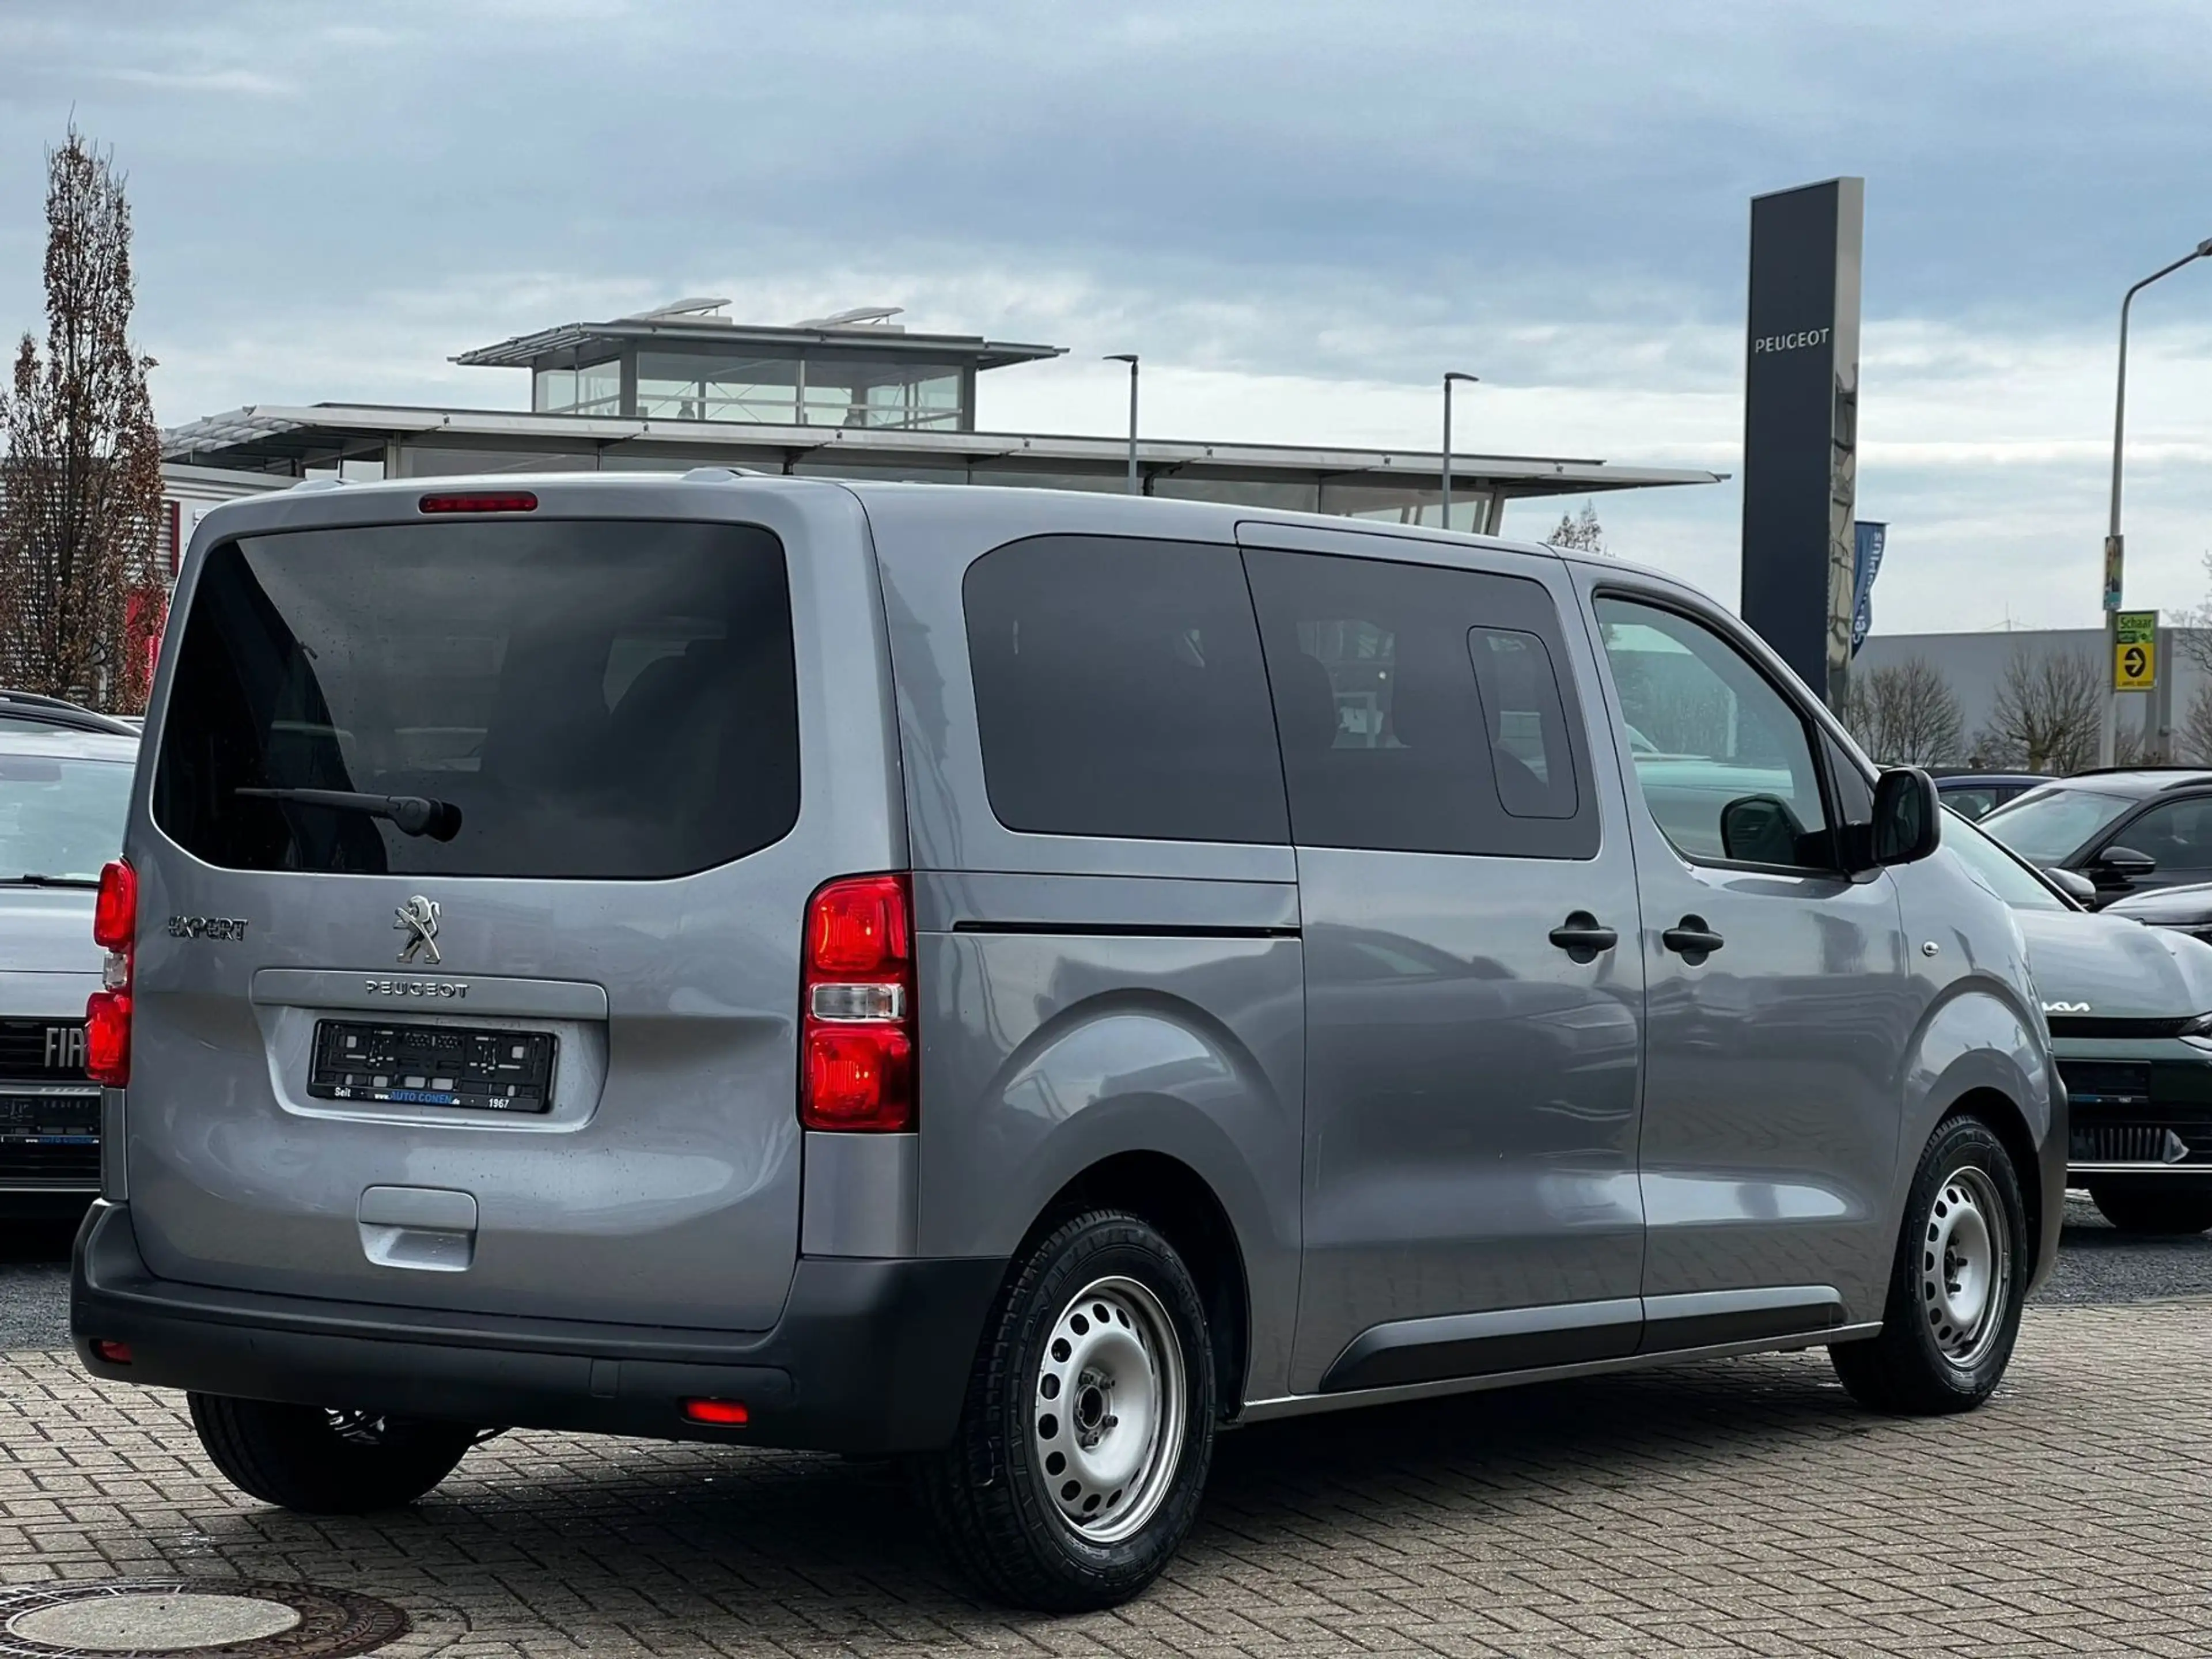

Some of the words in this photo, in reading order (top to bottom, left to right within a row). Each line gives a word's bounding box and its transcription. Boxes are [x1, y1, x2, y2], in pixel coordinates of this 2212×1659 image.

[1755, 328, 1830, 353] PEUGEOT
[2120, 616, 2152, 628] Schaar
[168, 916, 248, 941] EXPERT
[365, 980, 469, 998] PEUGEOT
[45, 1028, 85, 1067] FIA
[335, 1086, 351, 1097] Seit
[489, 1097, 509, 1108] 1967
